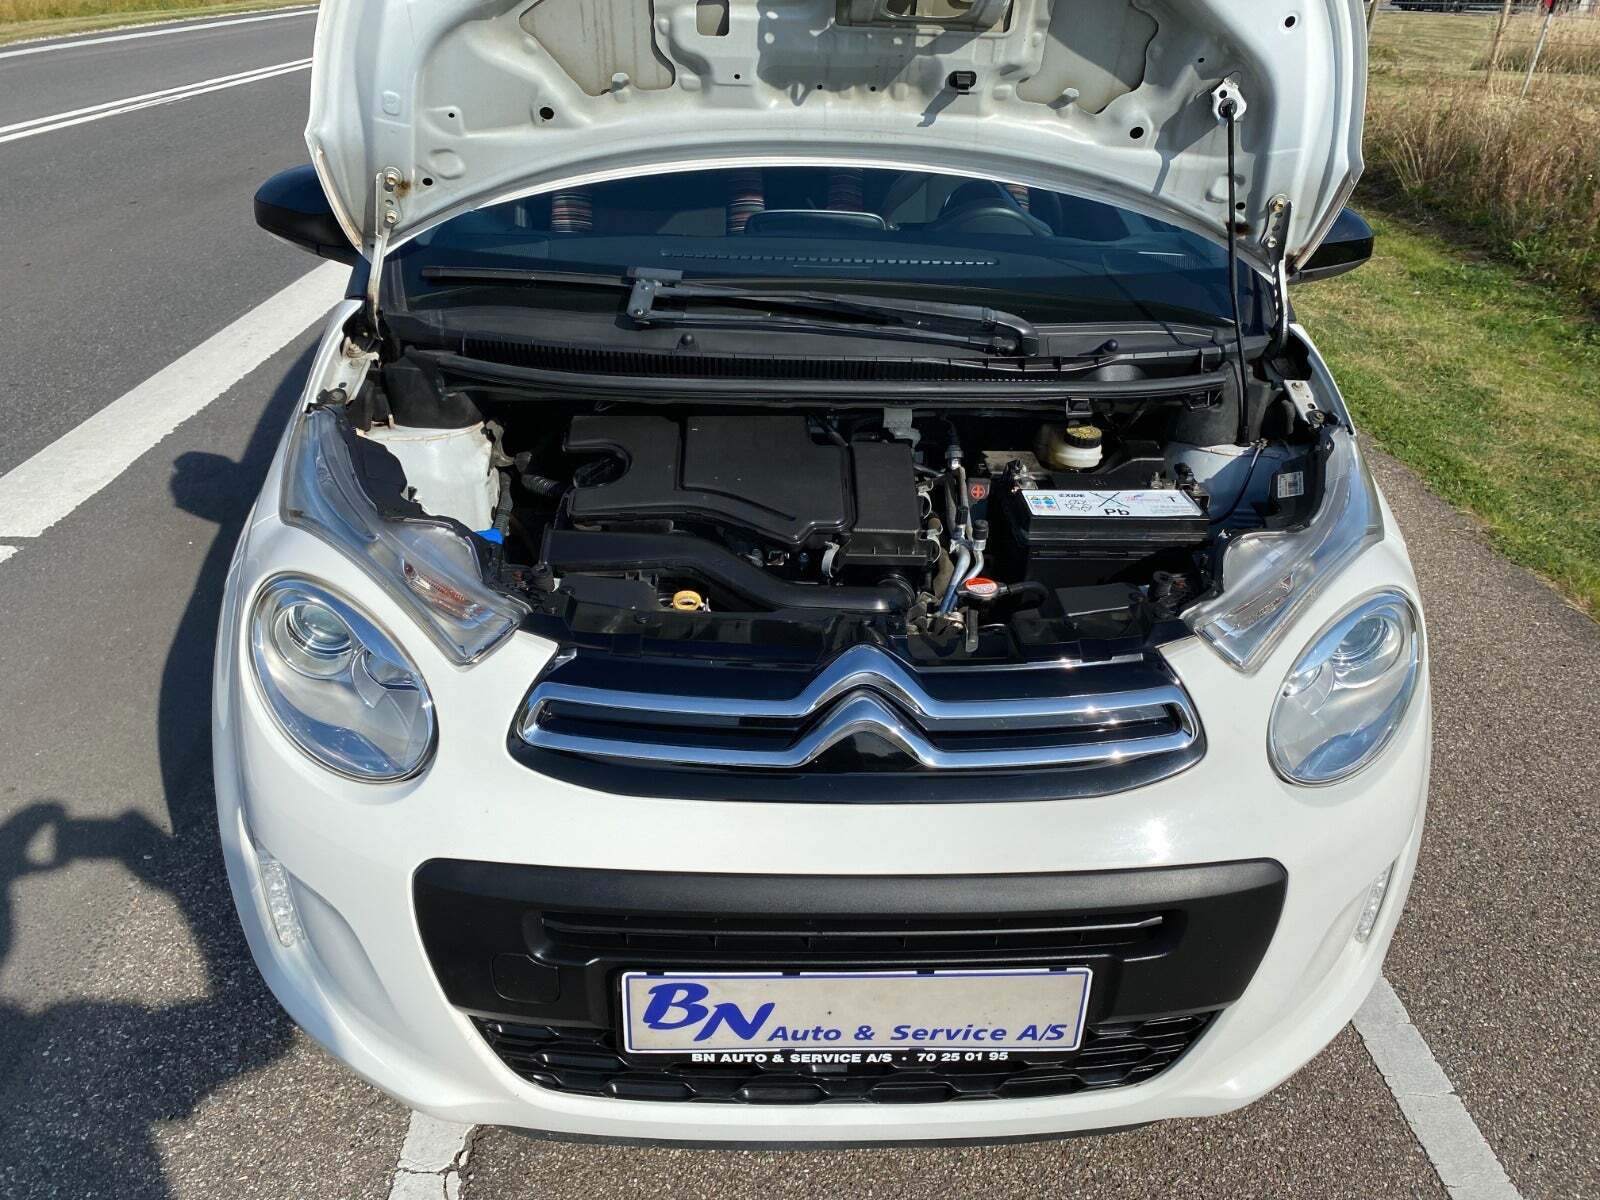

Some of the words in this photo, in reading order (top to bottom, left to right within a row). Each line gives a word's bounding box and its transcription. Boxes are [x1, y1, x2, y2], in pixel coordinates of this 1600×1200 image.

[1104, 508, 1130, 516] Pb
[642, 982, 776, 1042] BN
[768, 1025, 841, 1042] Auto
[853, 1025, 875, 1041] &
[889, 1023, 1007, 1041] Service
[1016, 1023, 1067, 1041] A/S
[692, 1053, 716, 1063] BN
[719, 1053, 767, 1063] AUTO
[772, 1053, 785, 1063] &
[790, 1053, 861, 1063] SERVICE
[866, 1053, 893, 1063] A/S
[917, 1052, 937, 1062] 70
[941, 1052, 960, 1062] 25
[964, 1052, 984, 1062] 01
[989, 1051, 1008, 1061] 95
